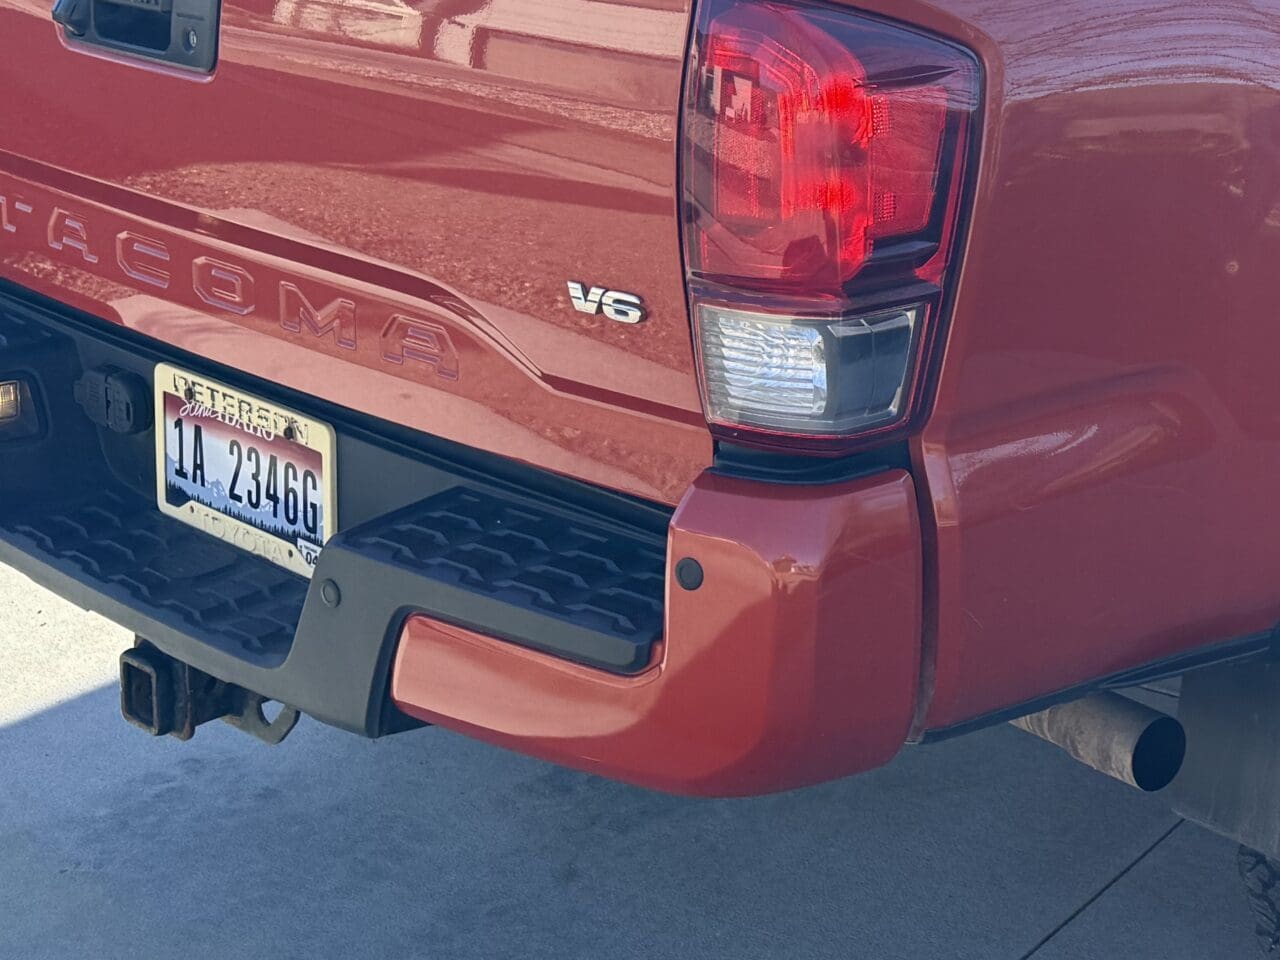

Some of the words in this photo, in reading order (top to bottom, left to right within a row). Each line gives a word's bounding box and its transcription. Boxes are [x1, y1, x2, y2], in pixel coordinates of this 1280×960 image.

[566, 280, 647, 324] V6
[174, 418, 206, 487] 1A
[228, 439, 318, 534] 2346G
